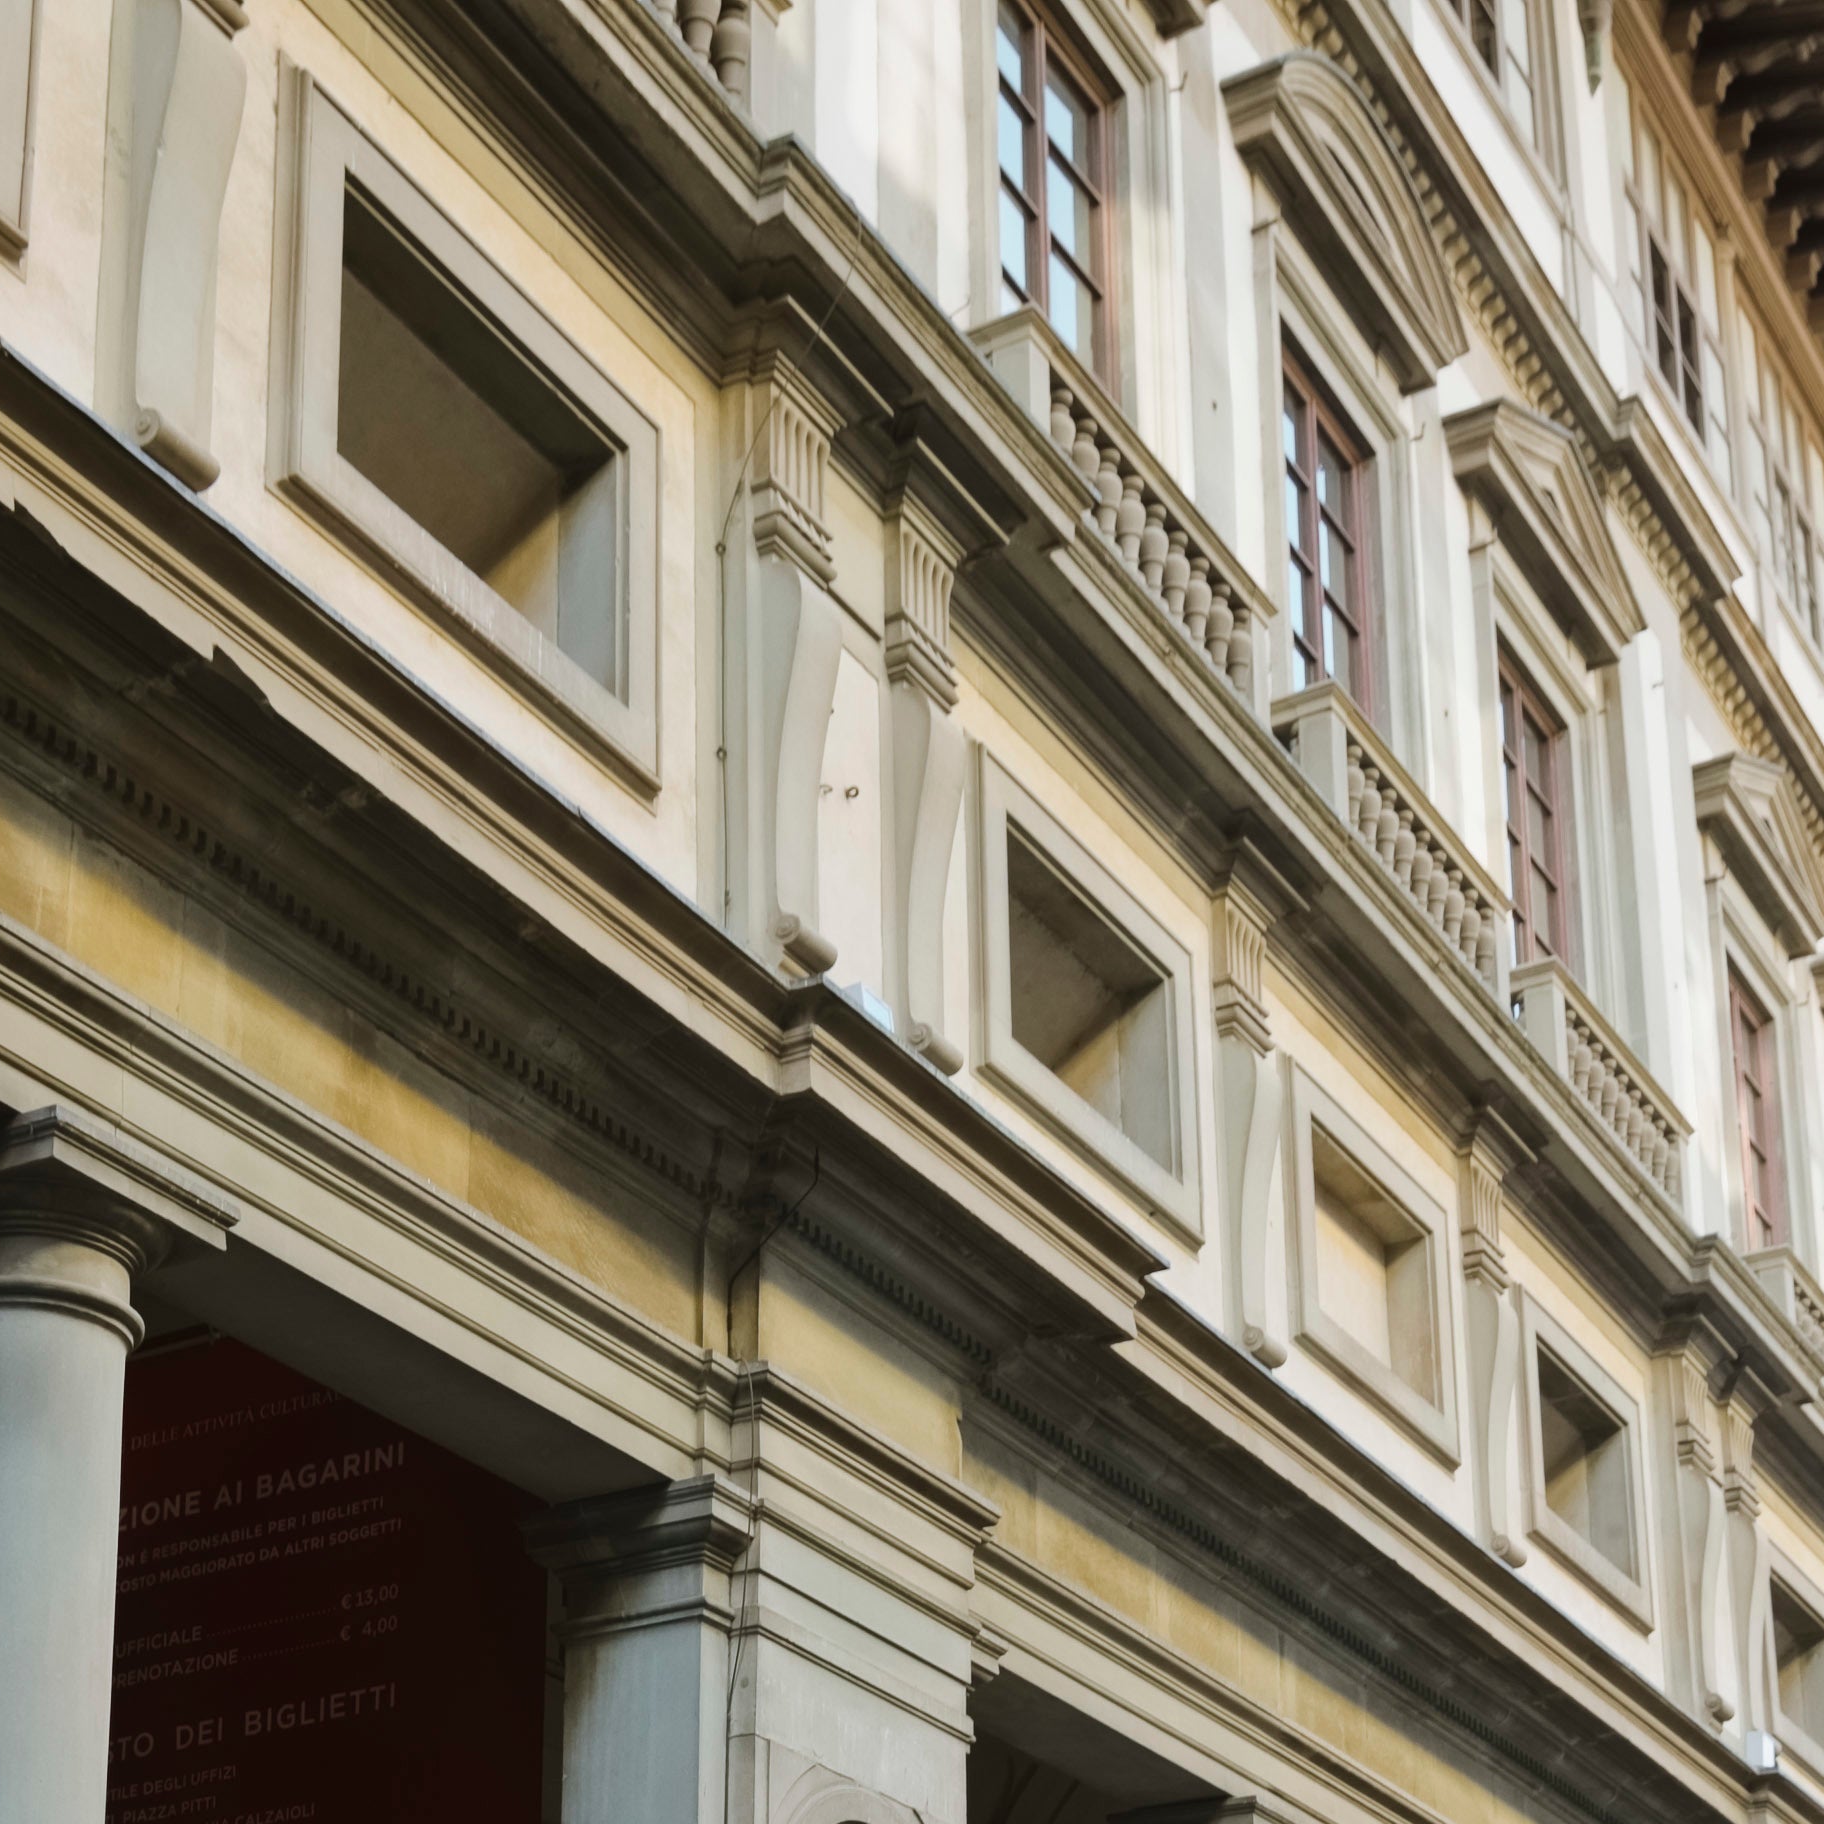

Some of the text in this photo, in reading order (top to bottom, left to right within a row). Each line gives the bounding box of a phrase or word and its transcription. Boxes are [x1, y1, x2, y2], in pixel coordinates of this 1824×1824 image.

[213, 1481, 243, 1510] AI
[256, 1441, 405, 1499] BAGARINI
[152, 1524, 263, 1560] RESPONSABILE
[268, 1516, 297, 1534] PER
[301, 1513, 307, 1527] I
[311, 1495, 384, 1526] BIGLIETTI
[116, 1517, 402, 1593] OSTO MAGGIORATO DA ALTRI SOGGETTI
[116, 1626, 203, 1659] UFFICIALE
[362, 1615, 398, 1637] 4,00
[176, 1716, 224, 1751] DEI
[245, 1682, 396, 1737] BIGLIETTI
[143, 1774, 187, 1796] DEGLI
[191, 1765, 236, 1787] UFFIZI
[123, 1804, 177, 1824] PIAZZA
[181, 1796, 217, 1814] PITTI
